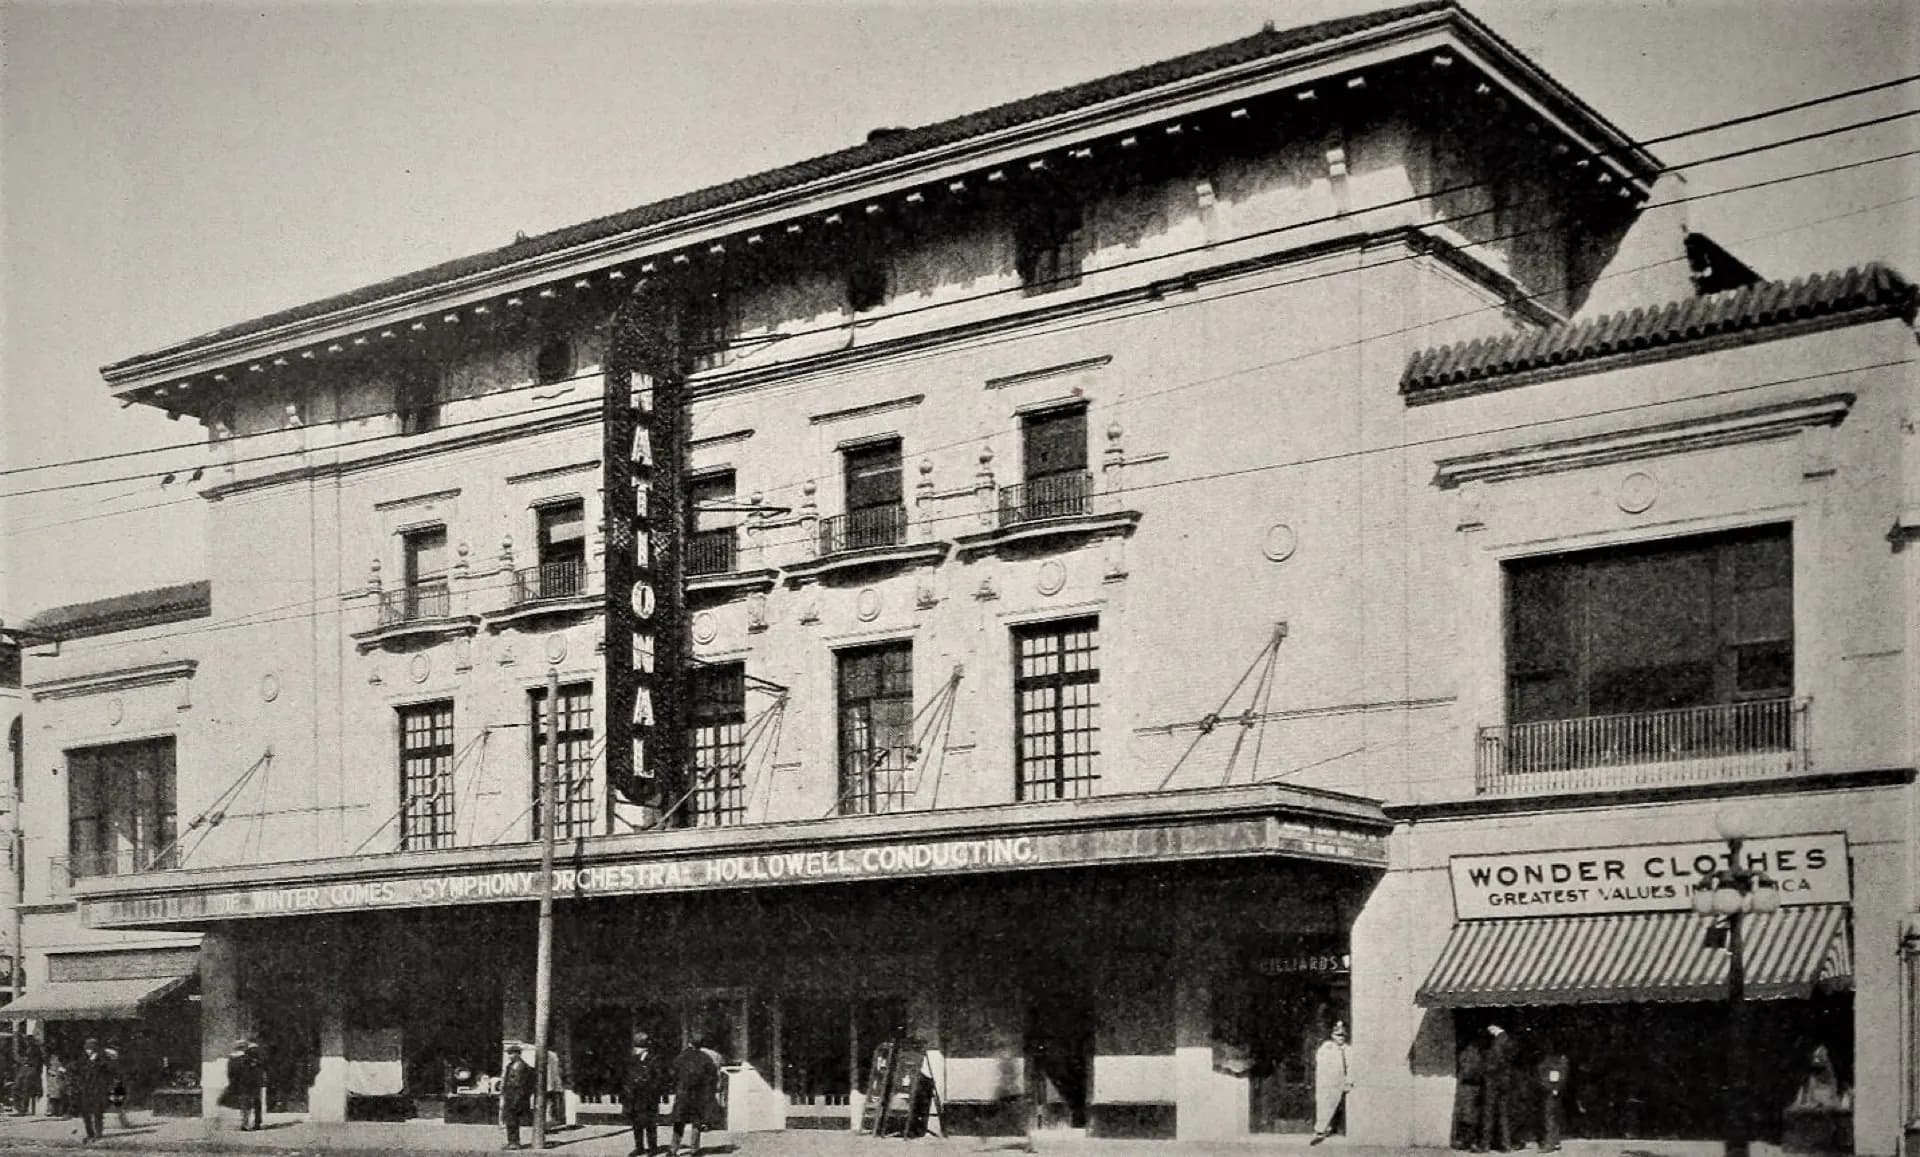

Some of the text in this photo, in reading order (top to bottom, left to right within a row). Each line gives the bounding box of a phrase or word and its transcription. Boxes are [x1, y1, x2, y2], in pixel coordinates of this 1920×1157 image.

[630, 371, 655, 778] NATIONAL
[1468, 848, 1827, 888] WONDER CLOTHES
[253, 887, 321, 911] WINTER
[330, 882, 396, 905] COMES
[419, 871, 533, 898] SYMPHONY
[1488, 889, 1589, 906] GREATEST
[1598, 884, 1676, 900] VALUES
